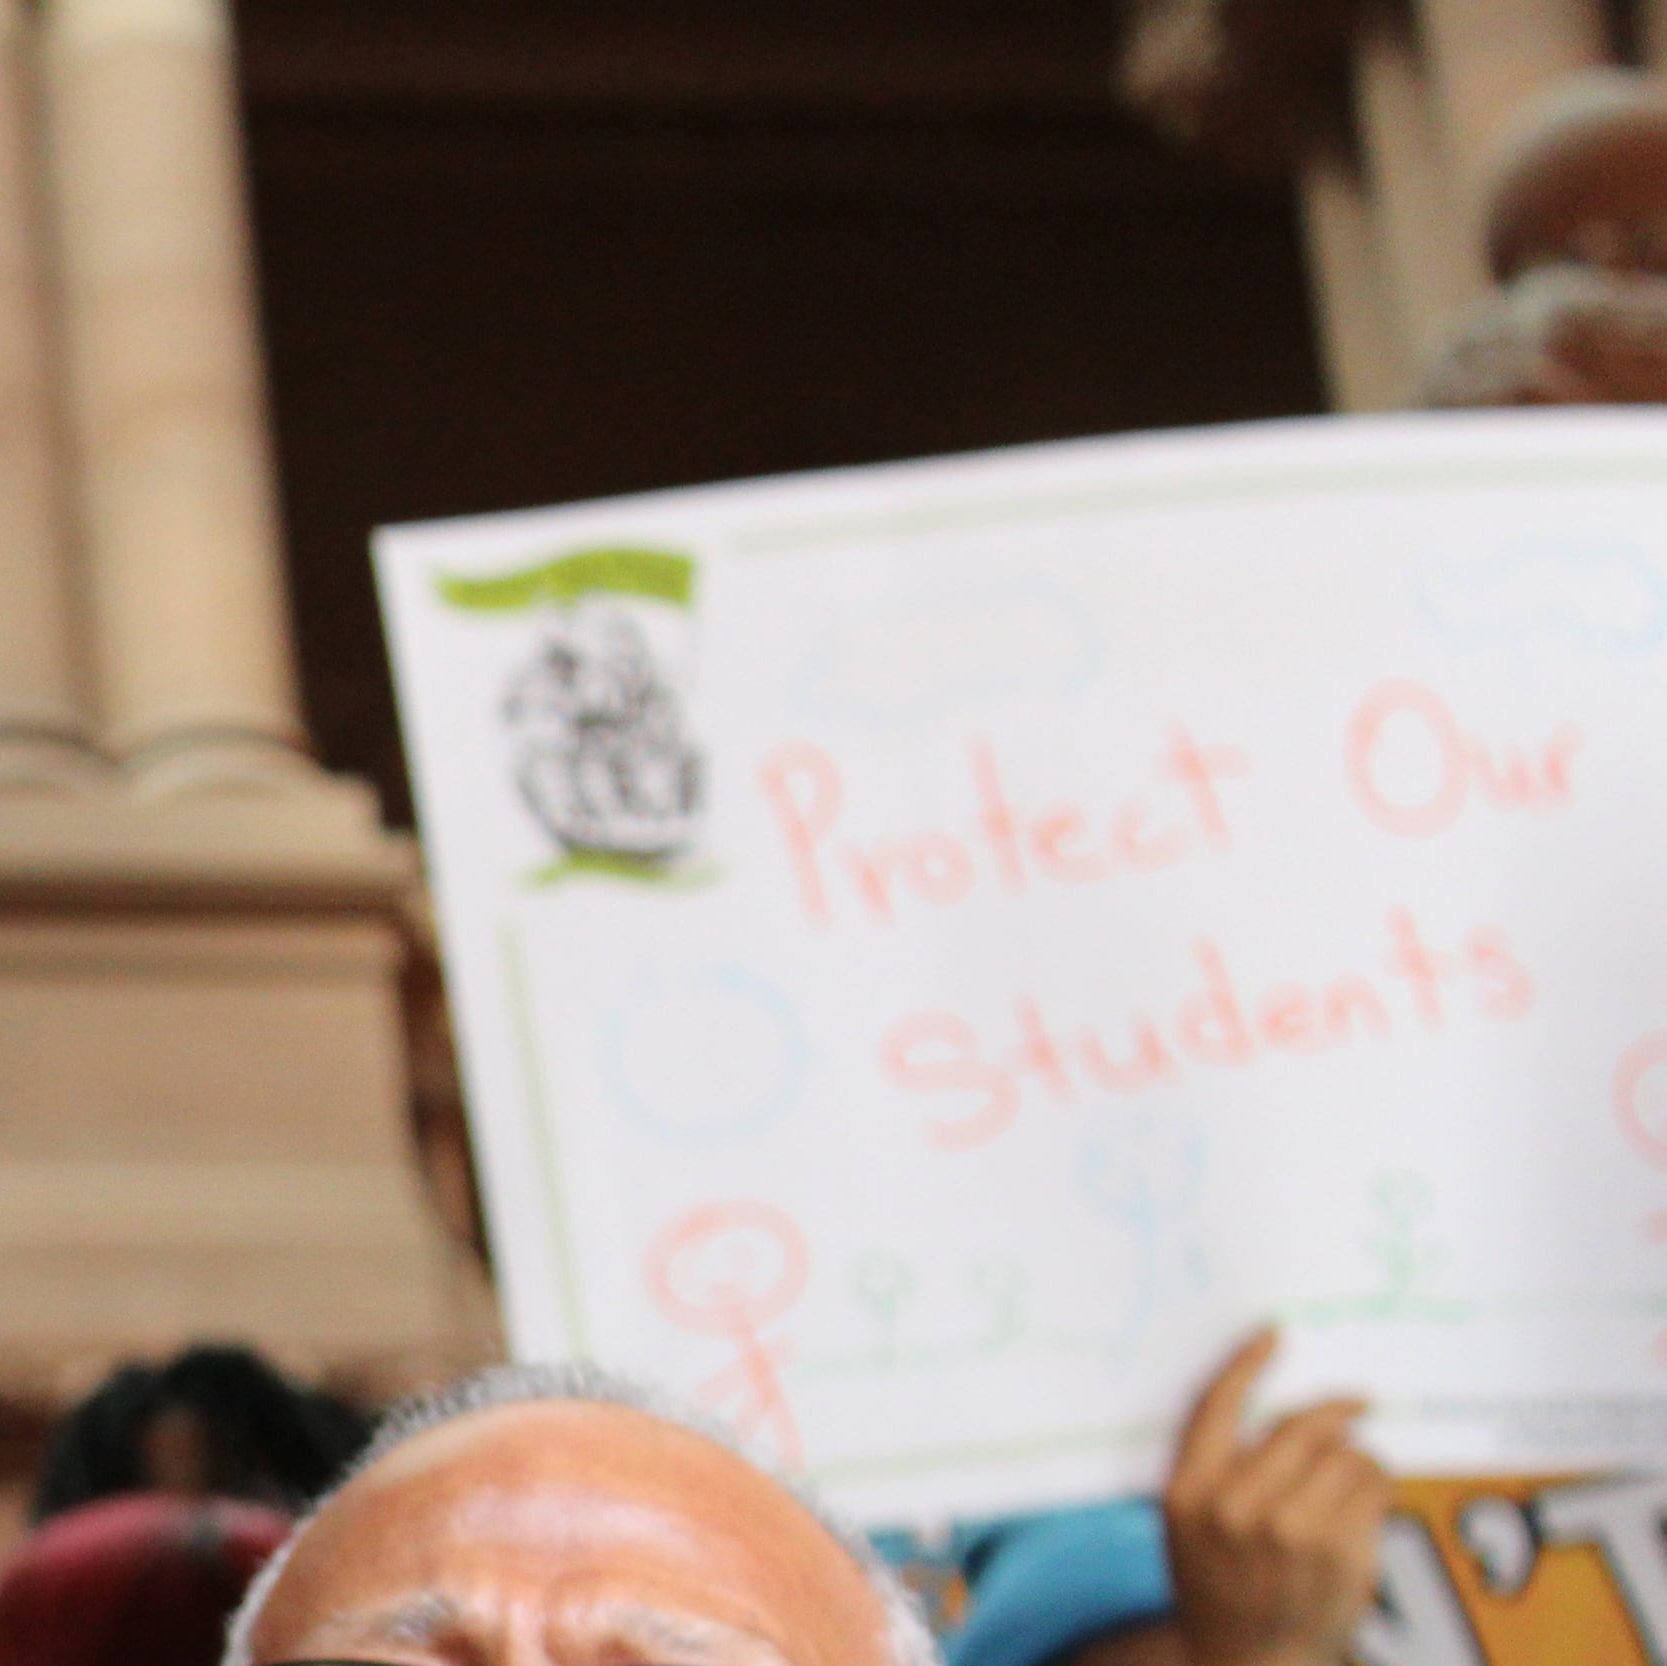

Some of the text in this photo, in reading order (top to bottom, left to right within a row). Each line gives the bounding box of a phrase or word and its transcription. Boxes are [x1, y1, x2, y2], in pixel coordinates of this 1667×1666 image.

[753, 675, 1588, 932] Protect Our
[878, 899, 1538, 1155] Students
